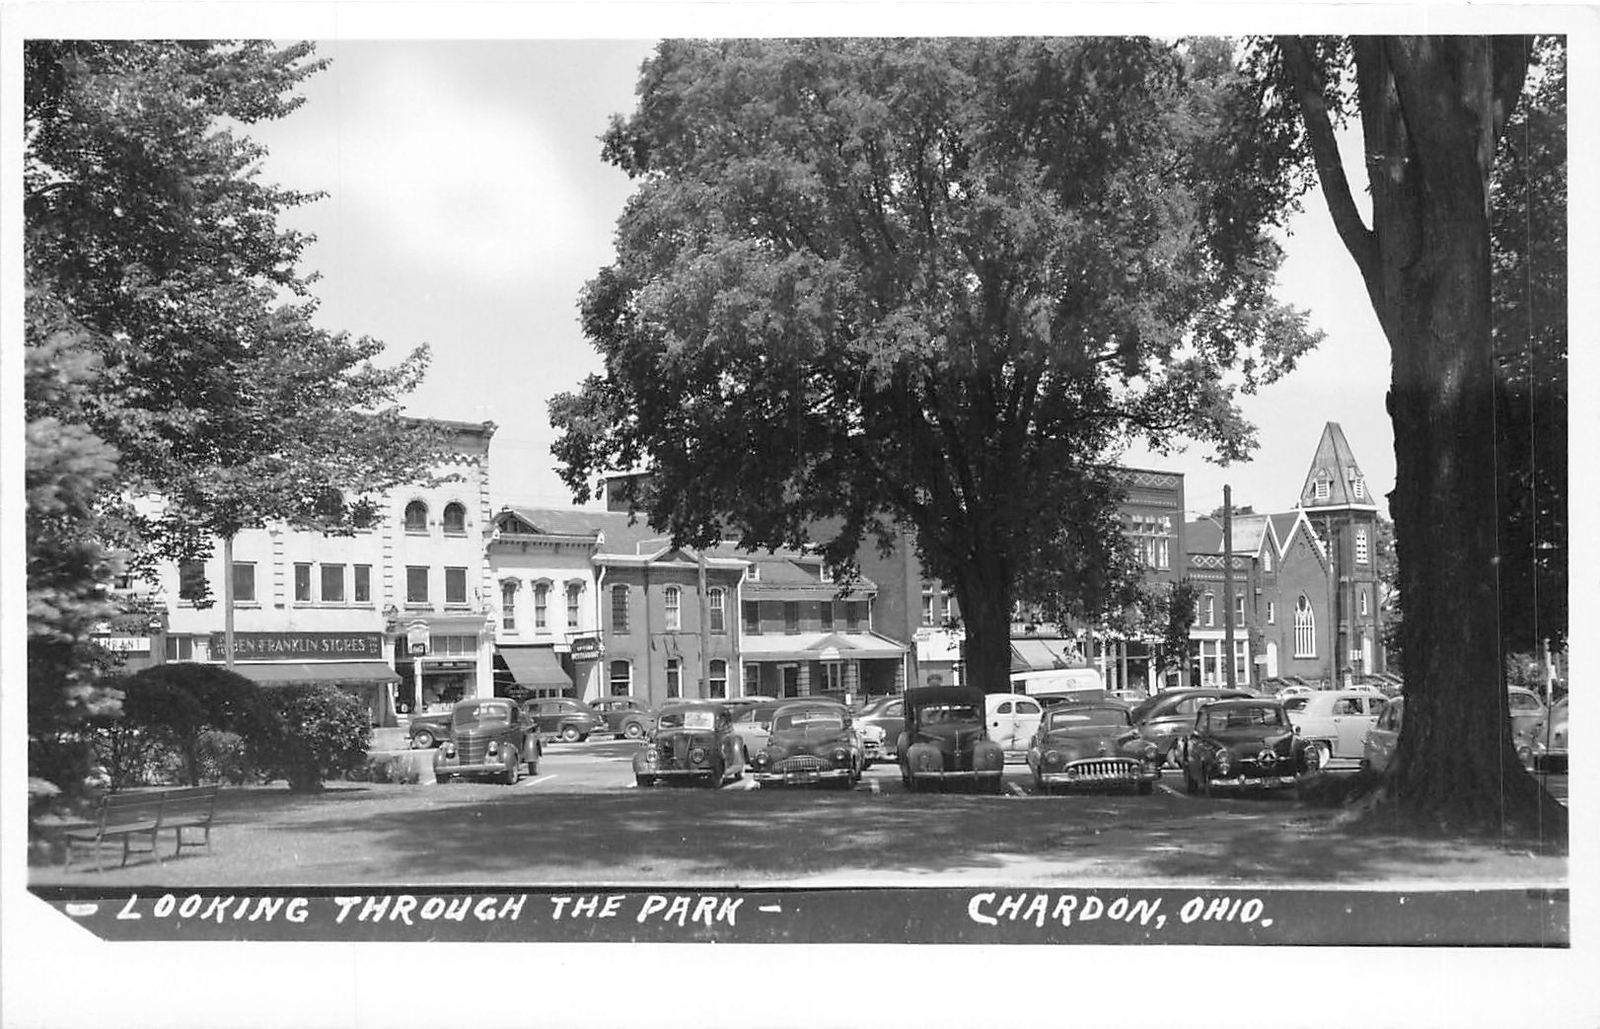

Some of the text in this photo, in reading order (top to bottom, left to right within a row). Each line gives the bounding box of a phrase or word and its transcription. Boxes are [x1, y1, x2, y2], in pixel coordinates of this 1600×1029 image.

[233, 639, 256, 653] BEN
[258, 638, 318, 653] FRANKLIN
[322, 637, 366, 652] STORES
